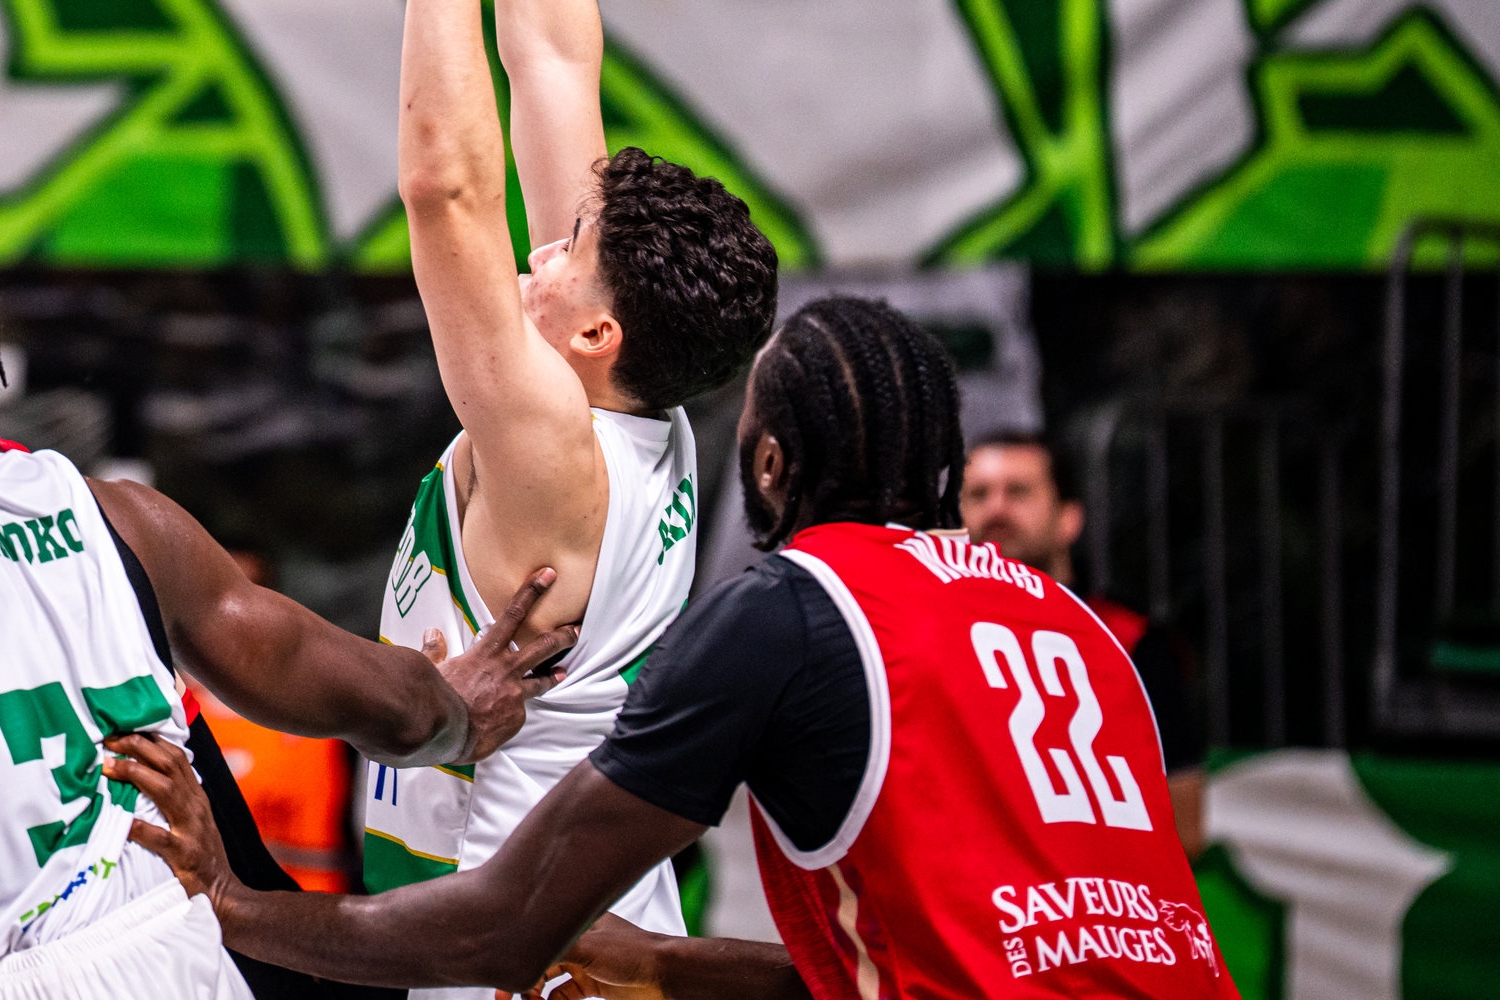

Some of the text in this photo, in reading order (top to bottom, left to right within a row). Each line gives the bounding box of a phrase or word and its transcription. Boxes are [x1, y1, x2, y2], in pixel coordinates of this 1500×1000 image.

[970, 621, 1154, 831] 22
[991, 877, 1159, 934] SAVEURS
[1003, 937, 1033, 979] DES
[1035, 925, 1177, 973] MAUGES
